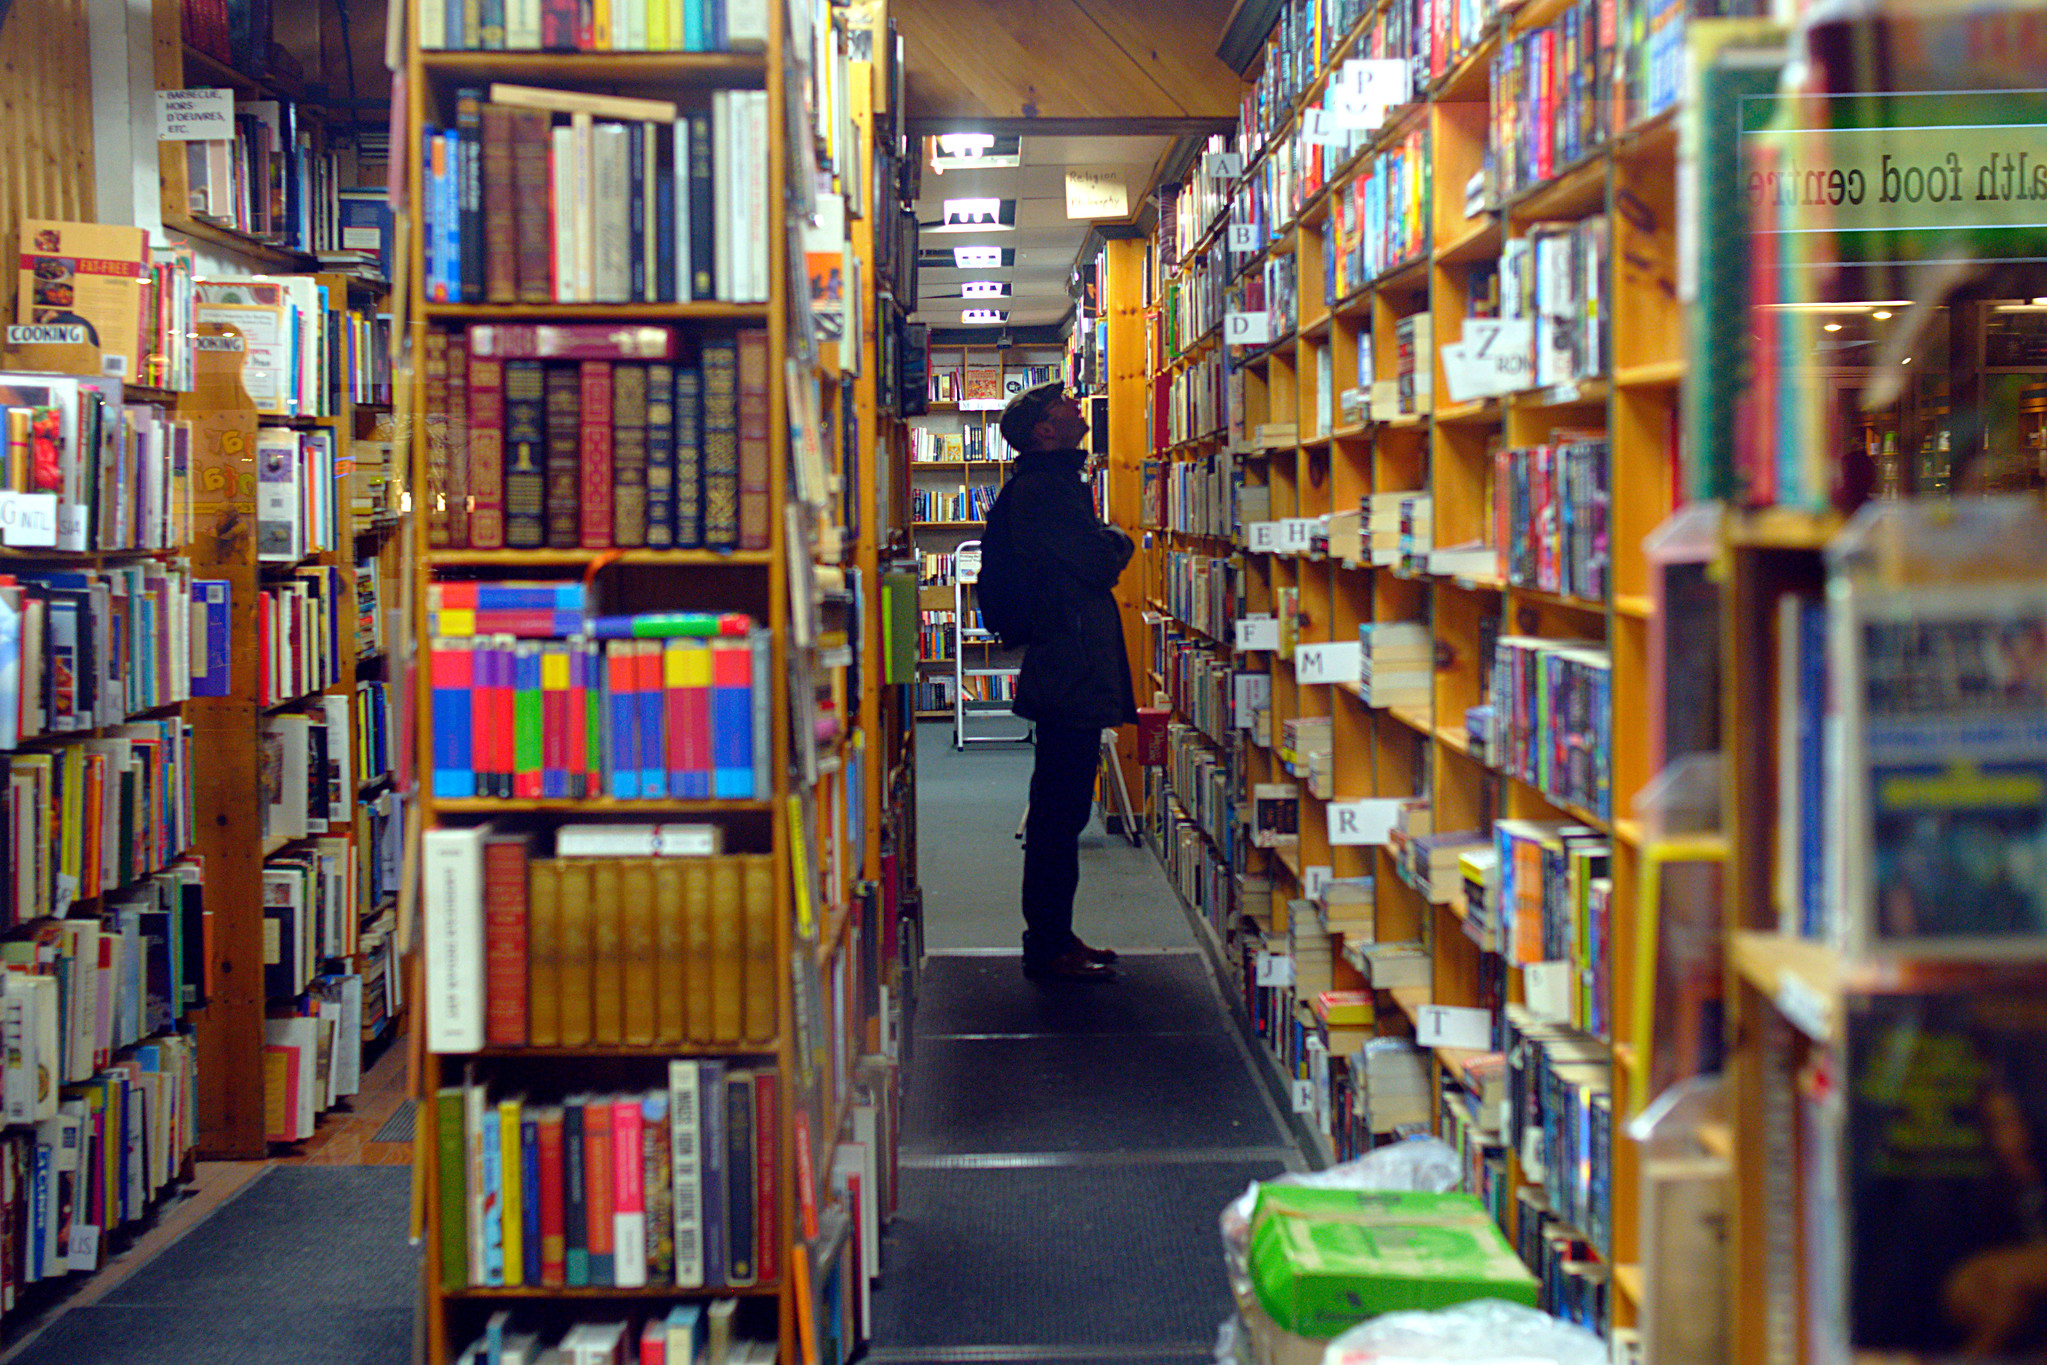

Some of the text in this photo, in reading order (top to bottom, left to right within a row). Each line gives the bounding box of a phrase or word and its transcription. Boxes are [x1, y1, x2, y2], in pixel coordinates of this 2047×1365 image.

[1358, 71, 1373, 94] P
[1216, 159, 1229, 174] A
[1070, 170, 1117, 184] Religion
[1237, 227, 1250, 244] B
[79, 259, 129, 275] FAT-FREE
[11, 327, 80, 341] COOKING
[1233, 316, 1248, 335] D
[1476, 325, 1501, 359] Z
[1258, 526, 1271, 545] E
[1289, 523, 1305, 542] H
[1244, 624, 1256, 642] F
[1301, 652, 1323, 673] M
[1339, 809, 1359, 833] R
[1264, 959, 1272, 977] J
[1427, 1009, 1449, 1035] T
